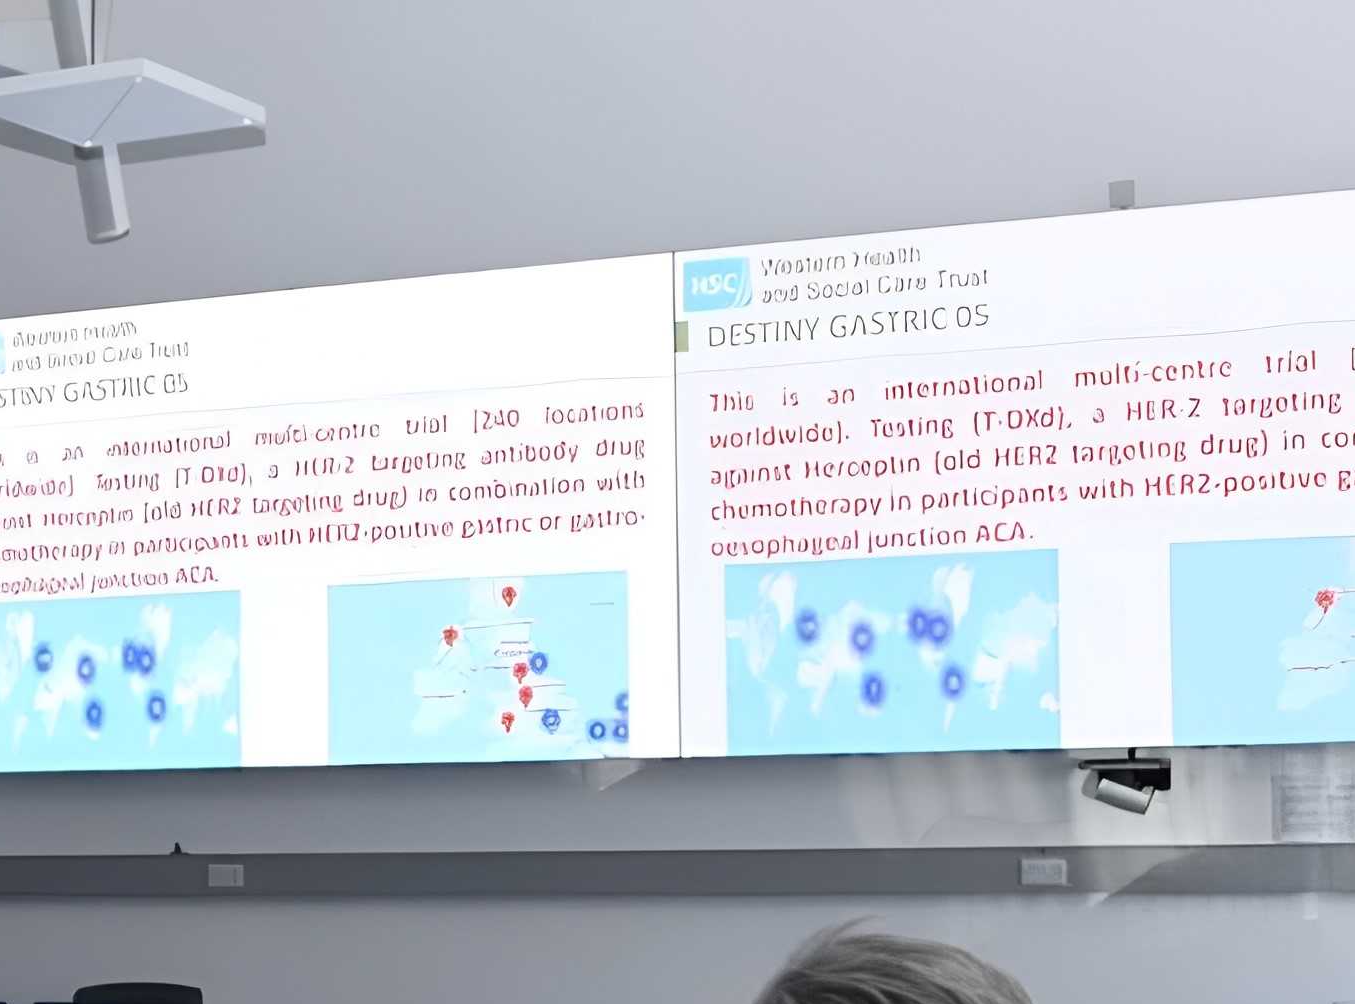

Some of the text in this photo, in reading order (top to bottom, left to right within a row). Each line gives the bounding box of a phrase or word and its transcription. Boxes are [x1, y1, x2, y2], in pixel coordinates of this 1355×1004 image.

[709, 317, 819, 347] DESTINY
[783, 387, 799, 406] is
[827, 387, 855, 405] an
[1223, 391, 1342, 418] targeting
[1073, 440, 1187, 466] targeting
[1283, 430, 1305, 450] in
[711, 497, 882, 521] chemotherapy
[891, 488, 911, 512] in
[922, 484, 1068, 513] participants
[1079, 479, 1134, 500] with
[868, 528, 966, 553] junction
